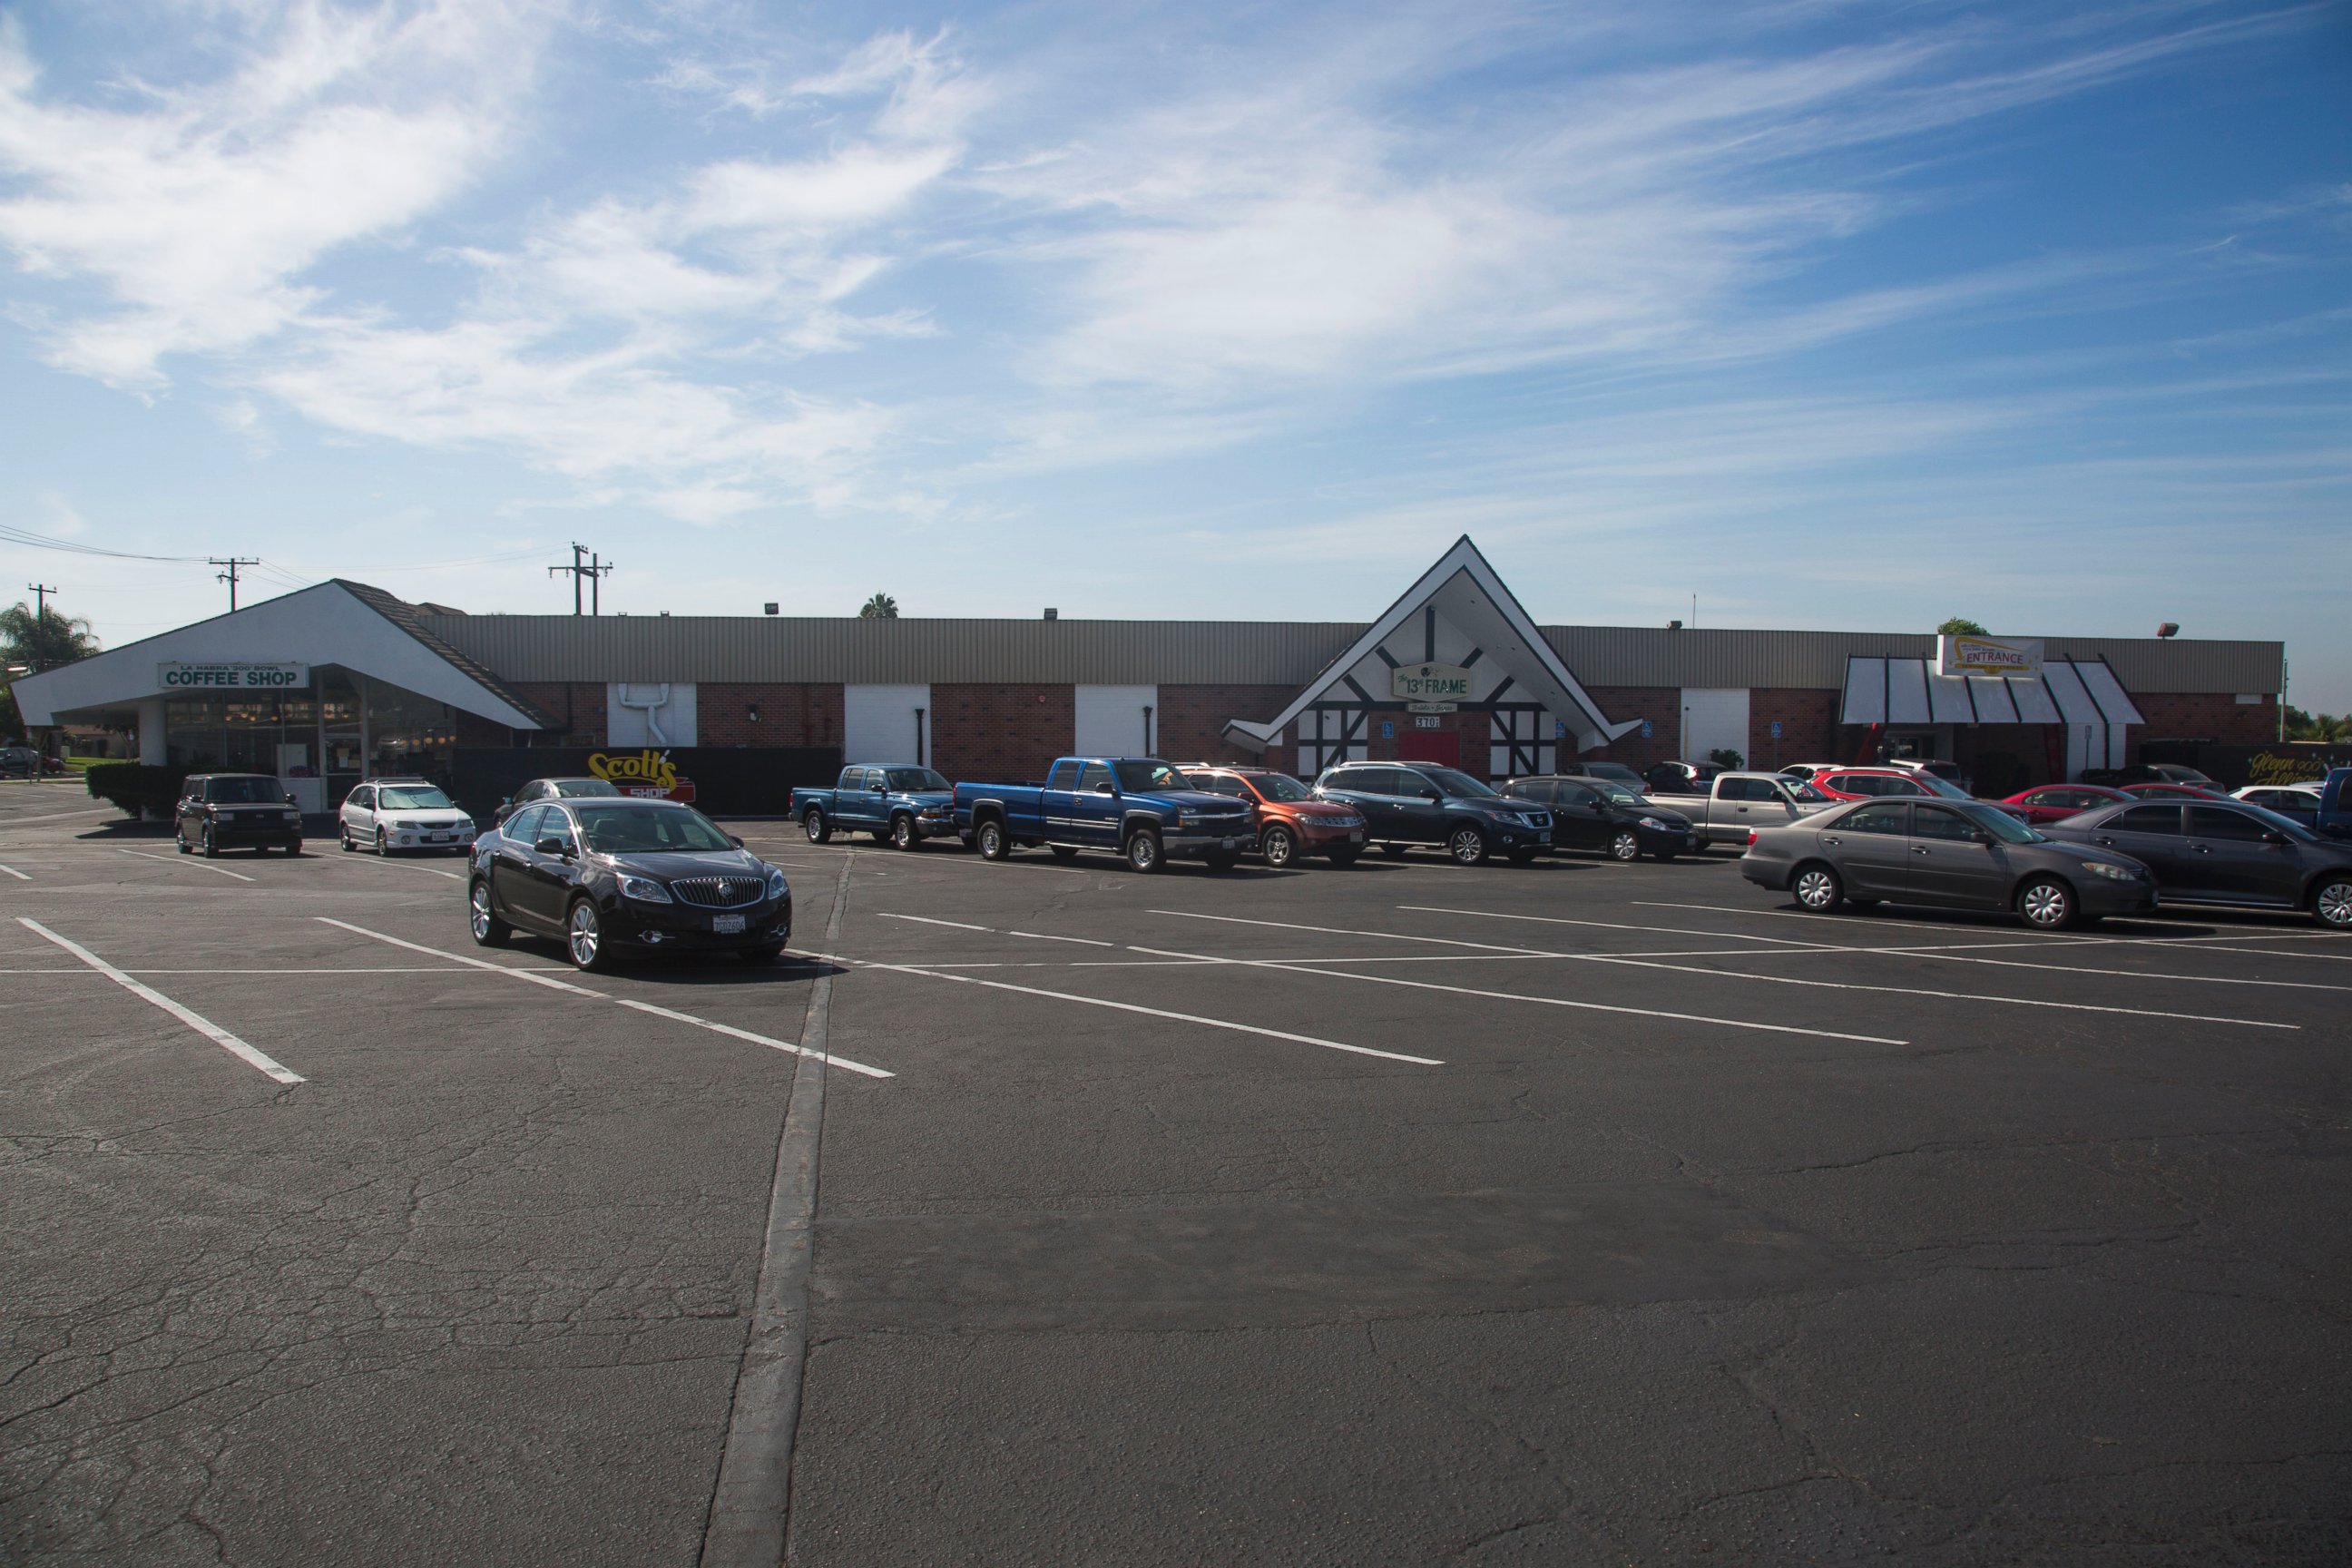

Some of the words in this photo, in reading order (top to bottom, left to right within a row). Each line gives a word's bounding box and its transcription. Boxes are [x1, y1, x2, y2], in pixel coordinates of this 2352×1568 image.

[1966, 652, 2024, 664] ENTRANCE
[166, 671, 240, 685] COFFEE
[247, 671, 297, 685] SHOP
[1425, 679, 1467, 693] FRAME
[2249, 753, 2295, 778] Glenn
[630, 789, 671, 799] SHOP
